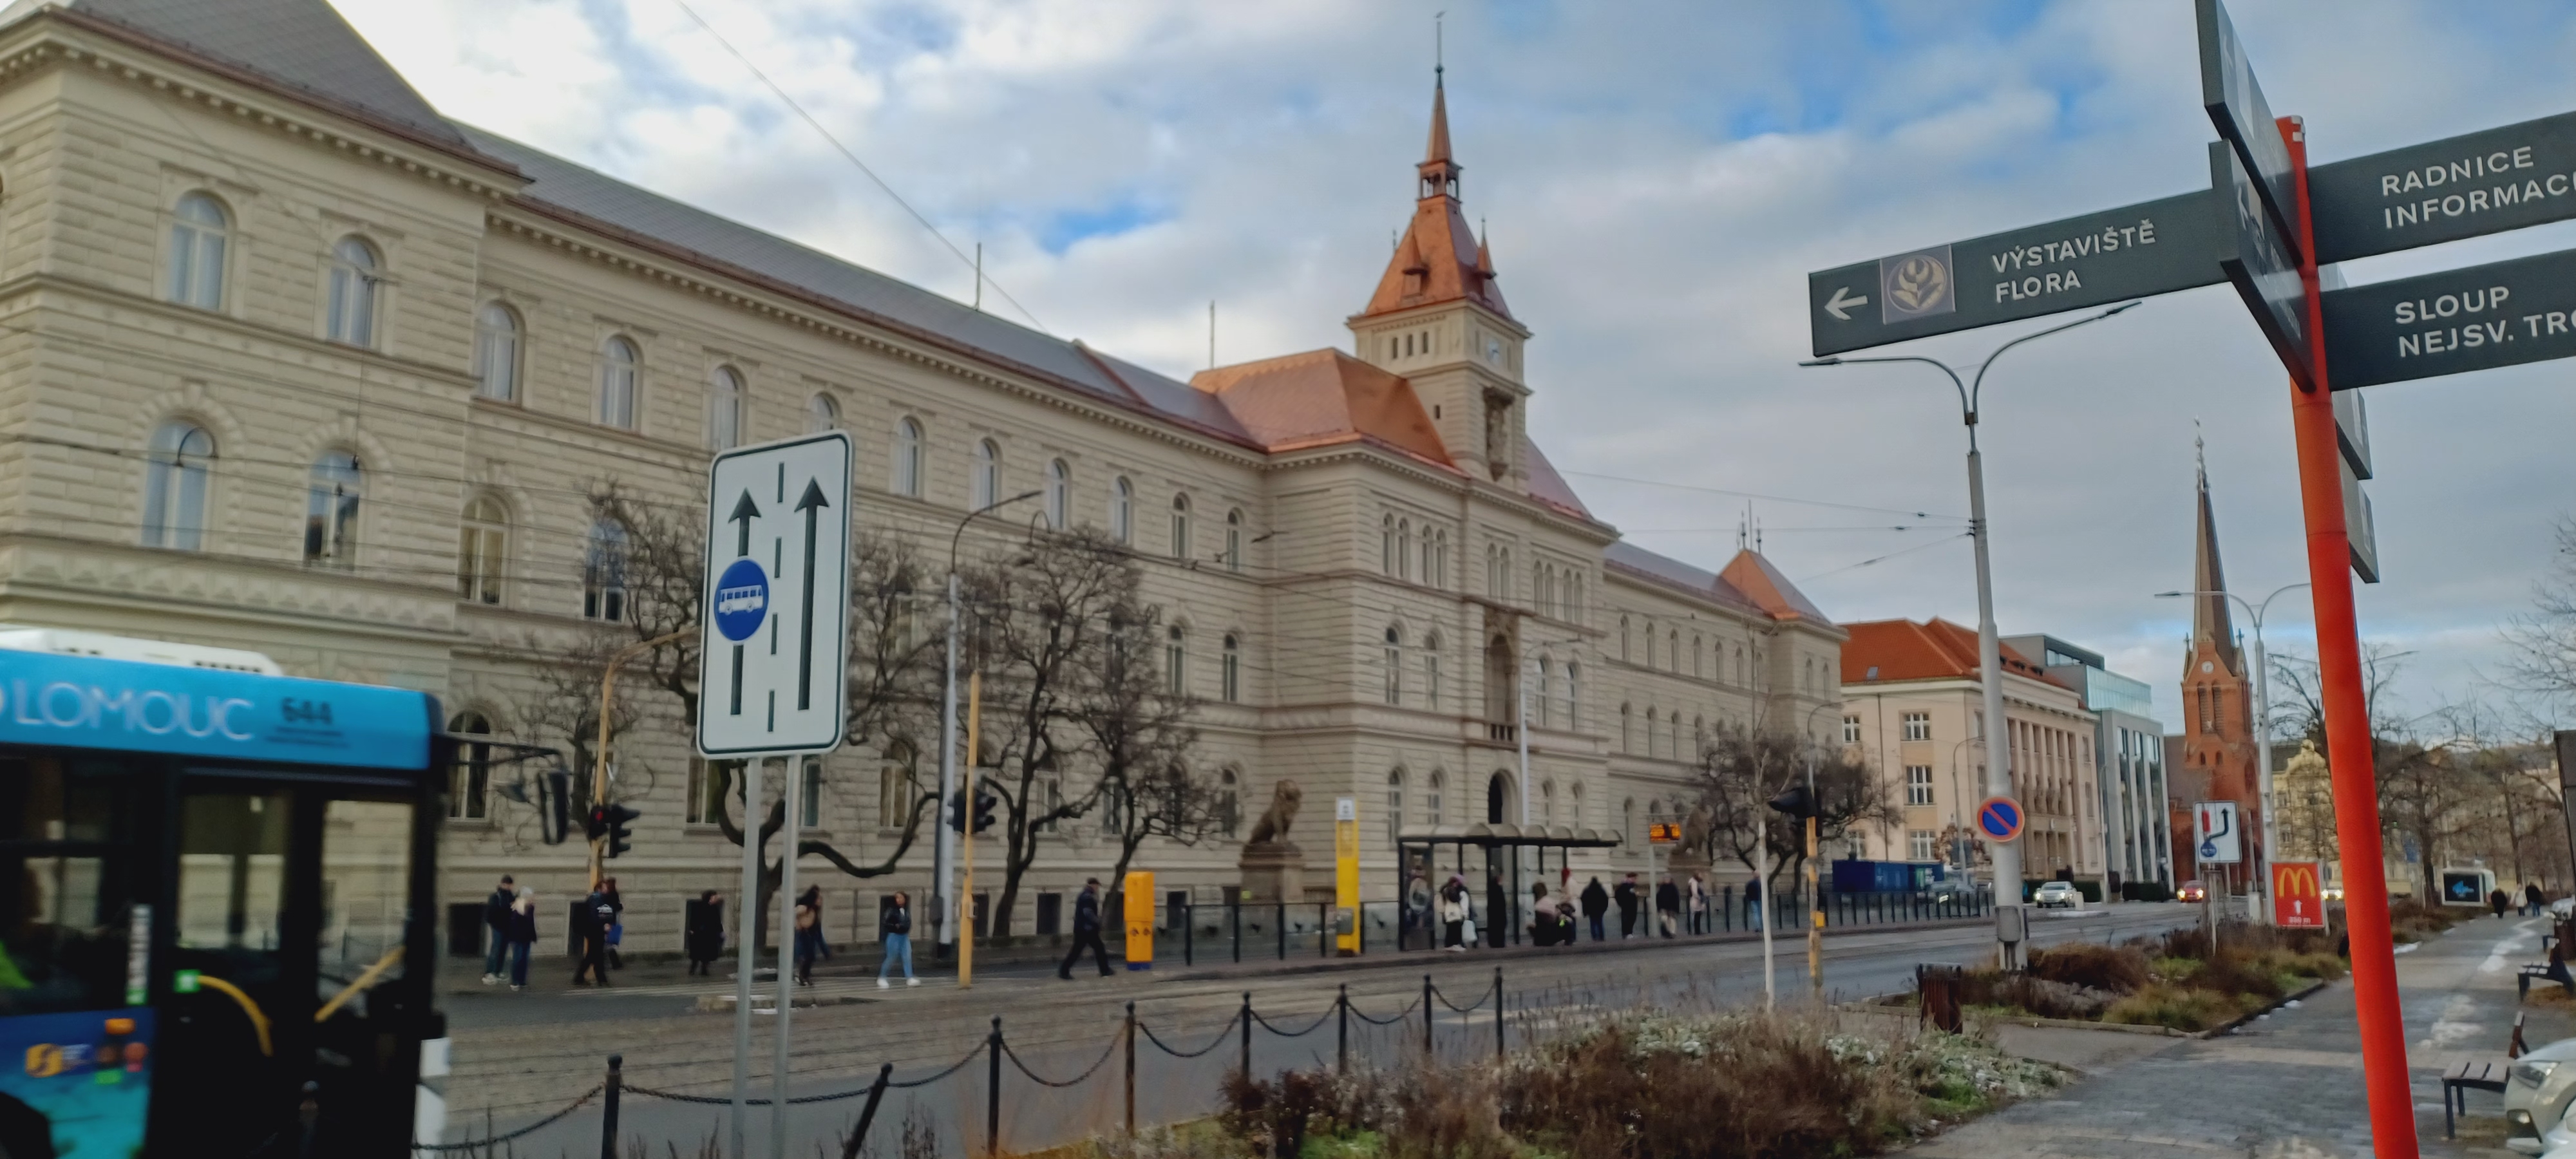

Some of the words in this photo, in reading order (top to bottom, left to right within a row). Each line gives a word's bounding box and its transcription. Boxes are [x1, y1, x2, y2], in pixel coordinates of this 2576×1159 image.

[2382, 146, 2534, 197] RADNICE
[1992, 218, 2156, 273] VÝSTAVIŠTĚ
[1995, 269, 2082, 303] FLORA
[2394, 286, 2510, 324] SLOUP
[2398, 319, 2514, 358] NEJSV.
[0, 678, 254, 740] LOMOUC
